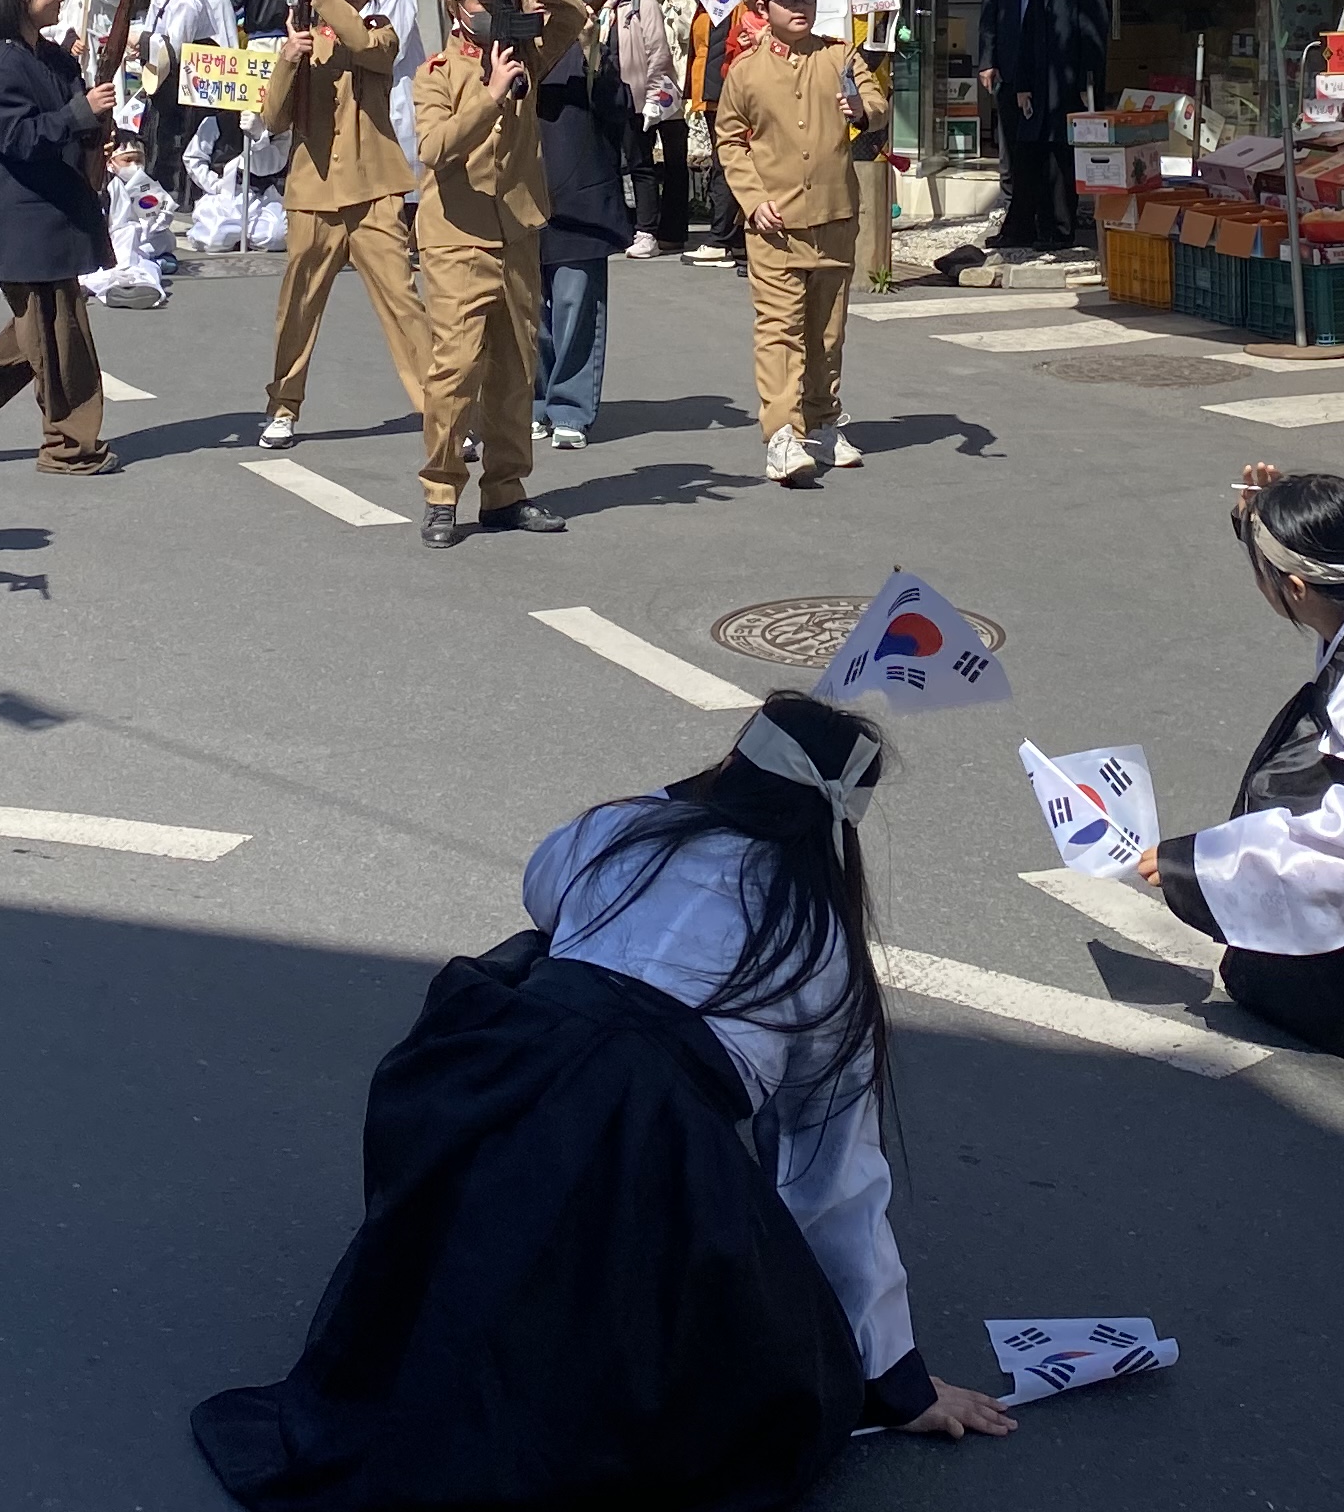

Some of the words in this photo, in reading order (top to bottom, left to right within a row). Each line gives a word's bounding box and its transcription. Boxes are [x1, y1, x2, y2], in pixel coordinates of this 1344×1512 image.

[189, 51, 239, 76] 사랑해요
[246, 58, 277, 80] 보훈
[198, 78, 249, 103] 함께해요
